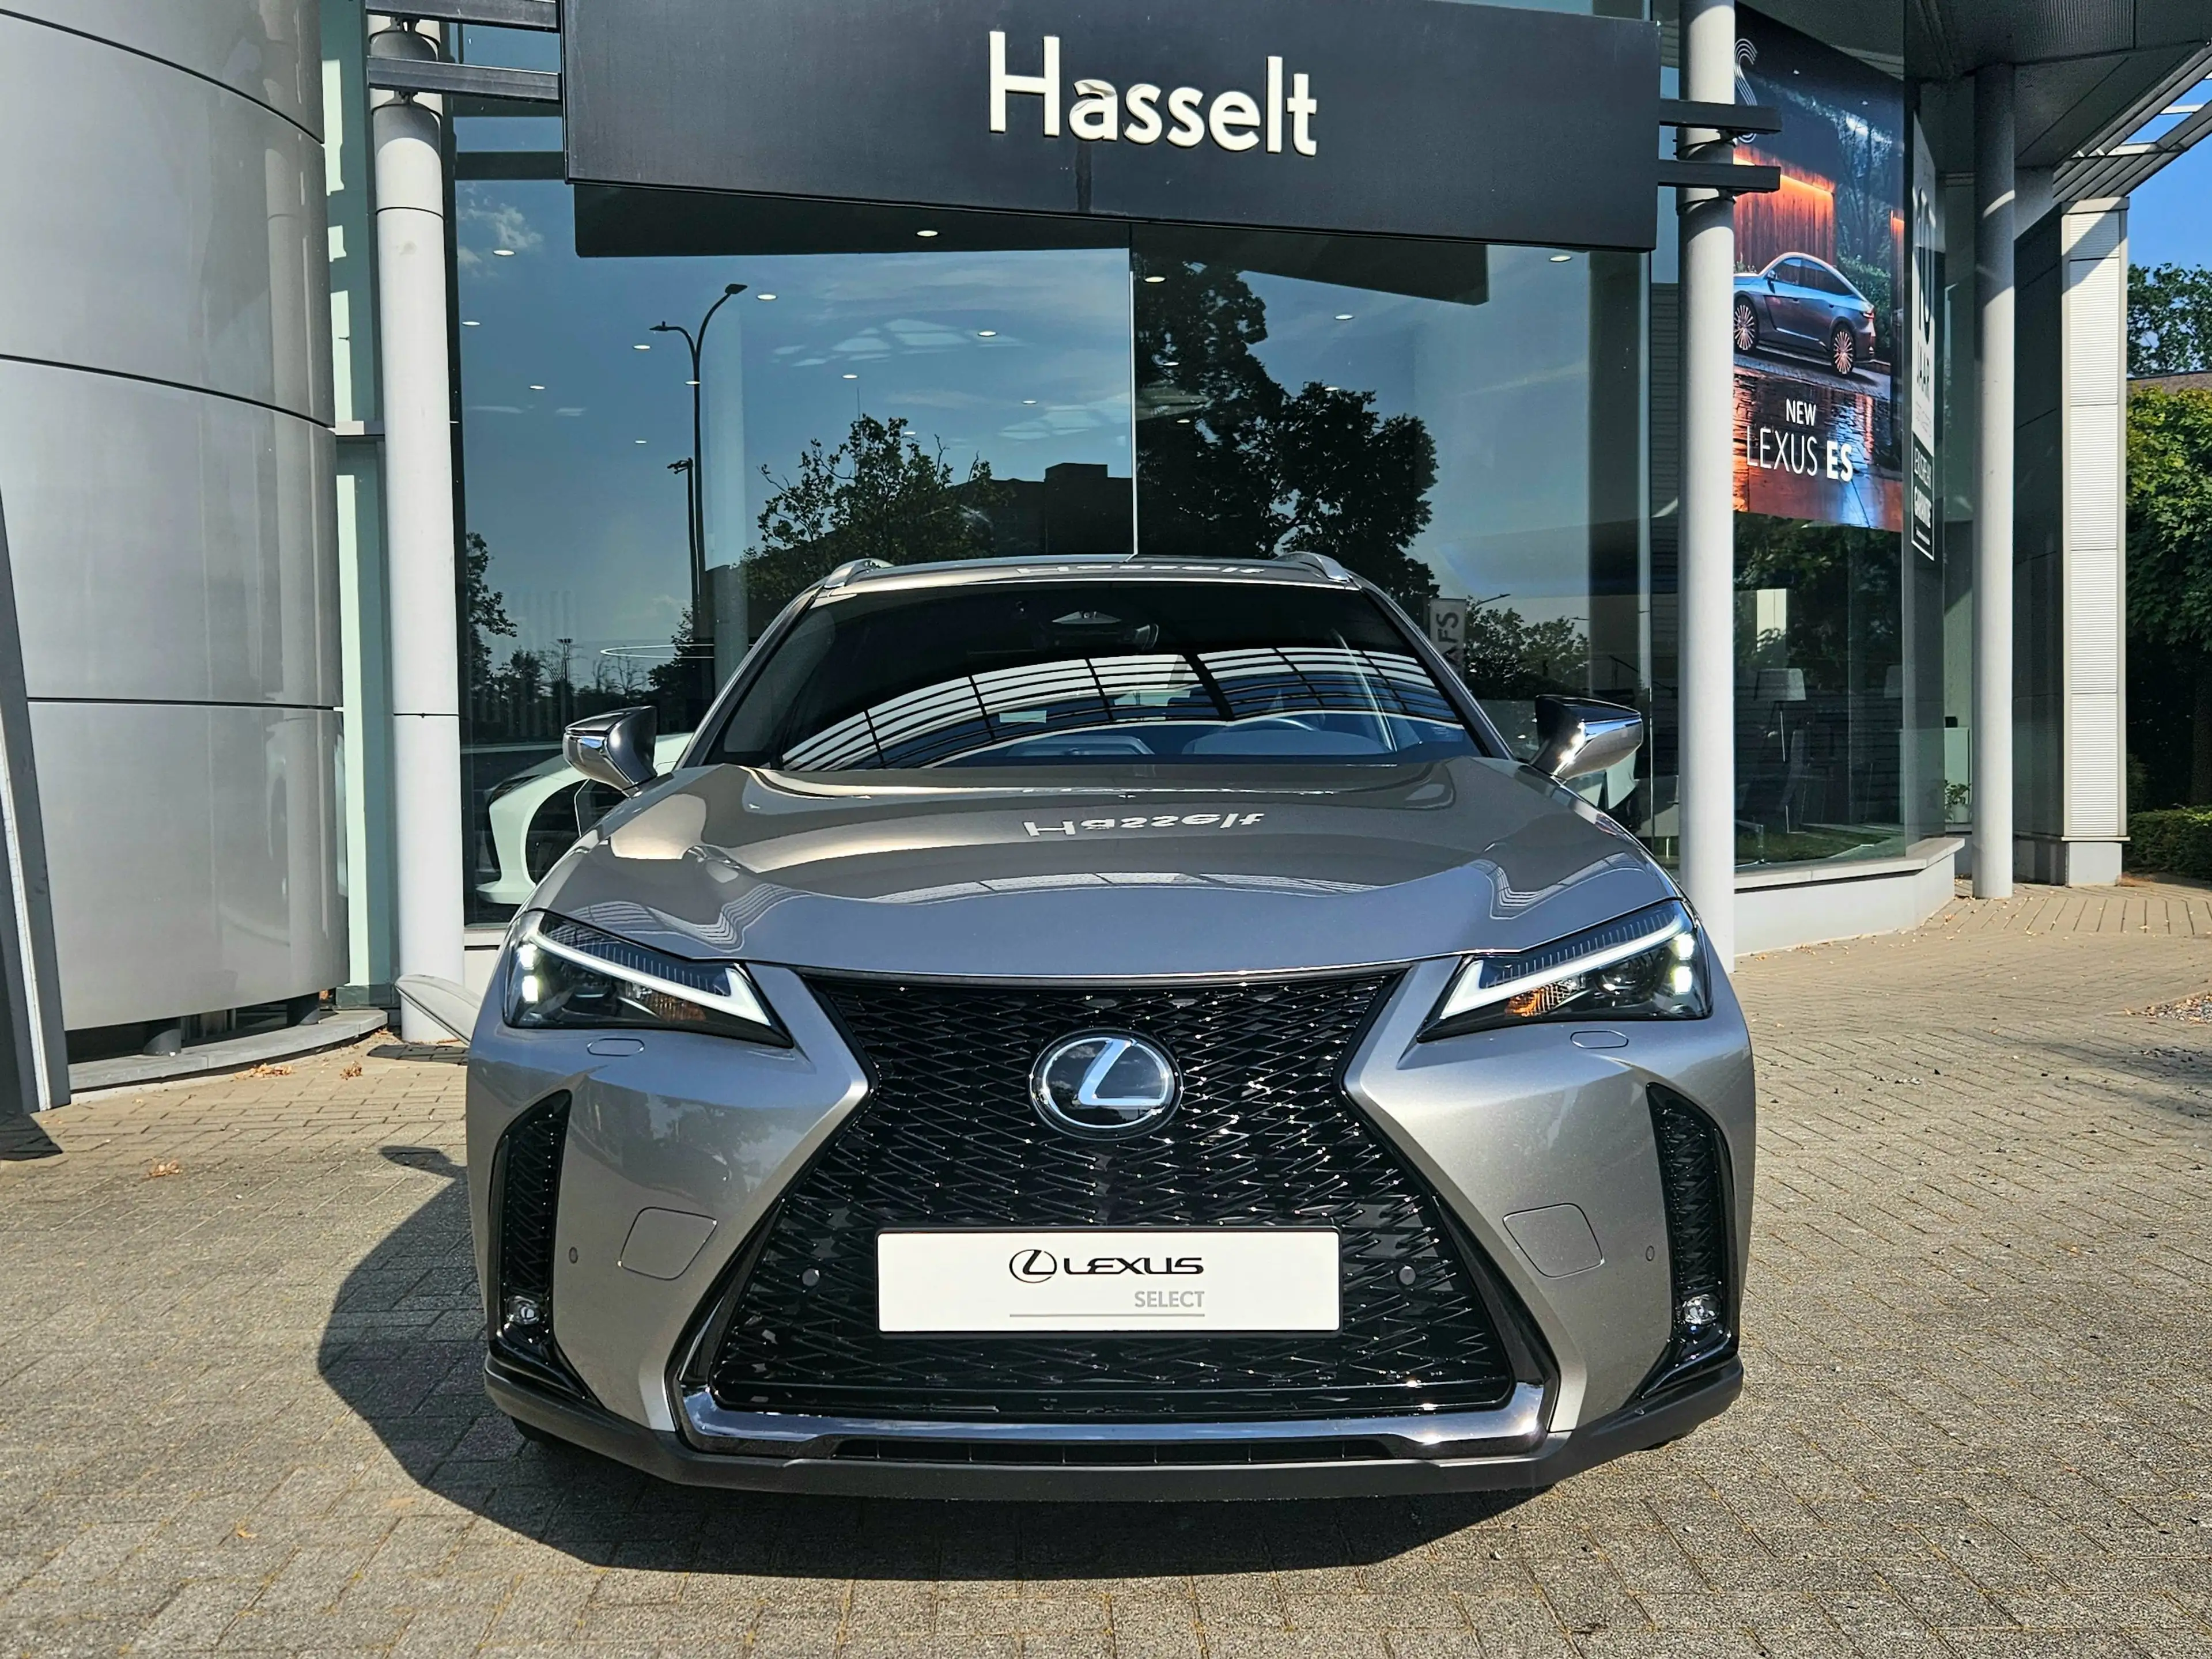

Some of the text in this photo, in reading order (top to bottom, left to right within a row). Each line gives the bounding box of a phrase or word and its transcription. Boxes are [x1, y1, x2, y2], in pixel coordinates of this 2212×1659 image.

[989, 31, 1317, 156] Hasselt
[1786, 398, 1816, 426] NEW
[1746, 425, 1853, 482] LEXUS ES
[1064, 1257, 1204, 1275] LEXUS
[1135, 1290, 1205, 1308] SELECT
